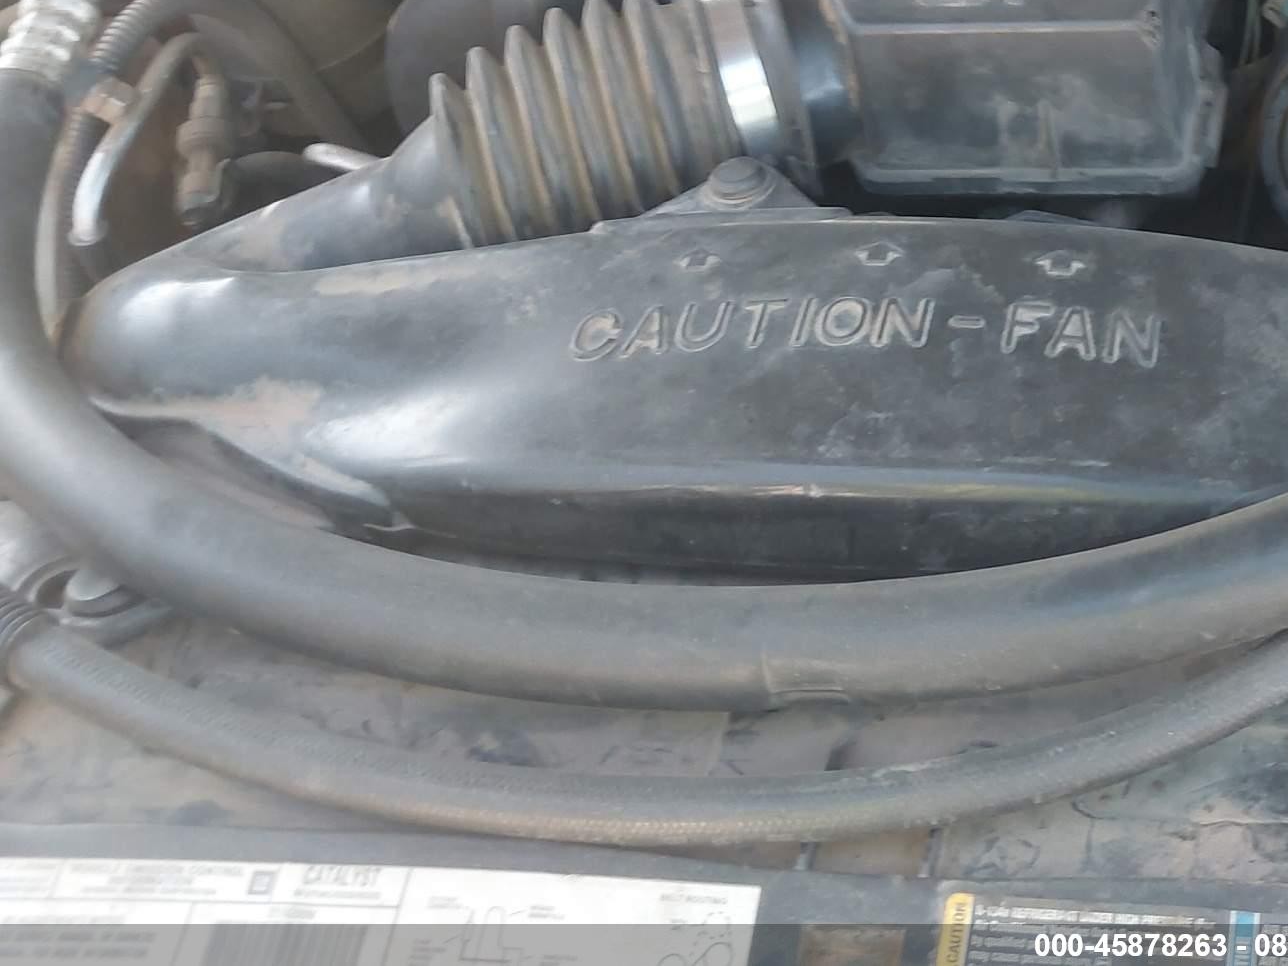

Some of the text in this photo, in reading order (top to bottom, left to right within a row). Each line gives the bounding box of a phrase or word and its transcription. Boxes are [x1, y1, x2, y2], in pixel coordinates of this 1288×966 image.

[568, 296, 933, 362] CAUTION
[1000, 299, 1163, 368] FAN
[946, 901, 966, 965] CAUTION
